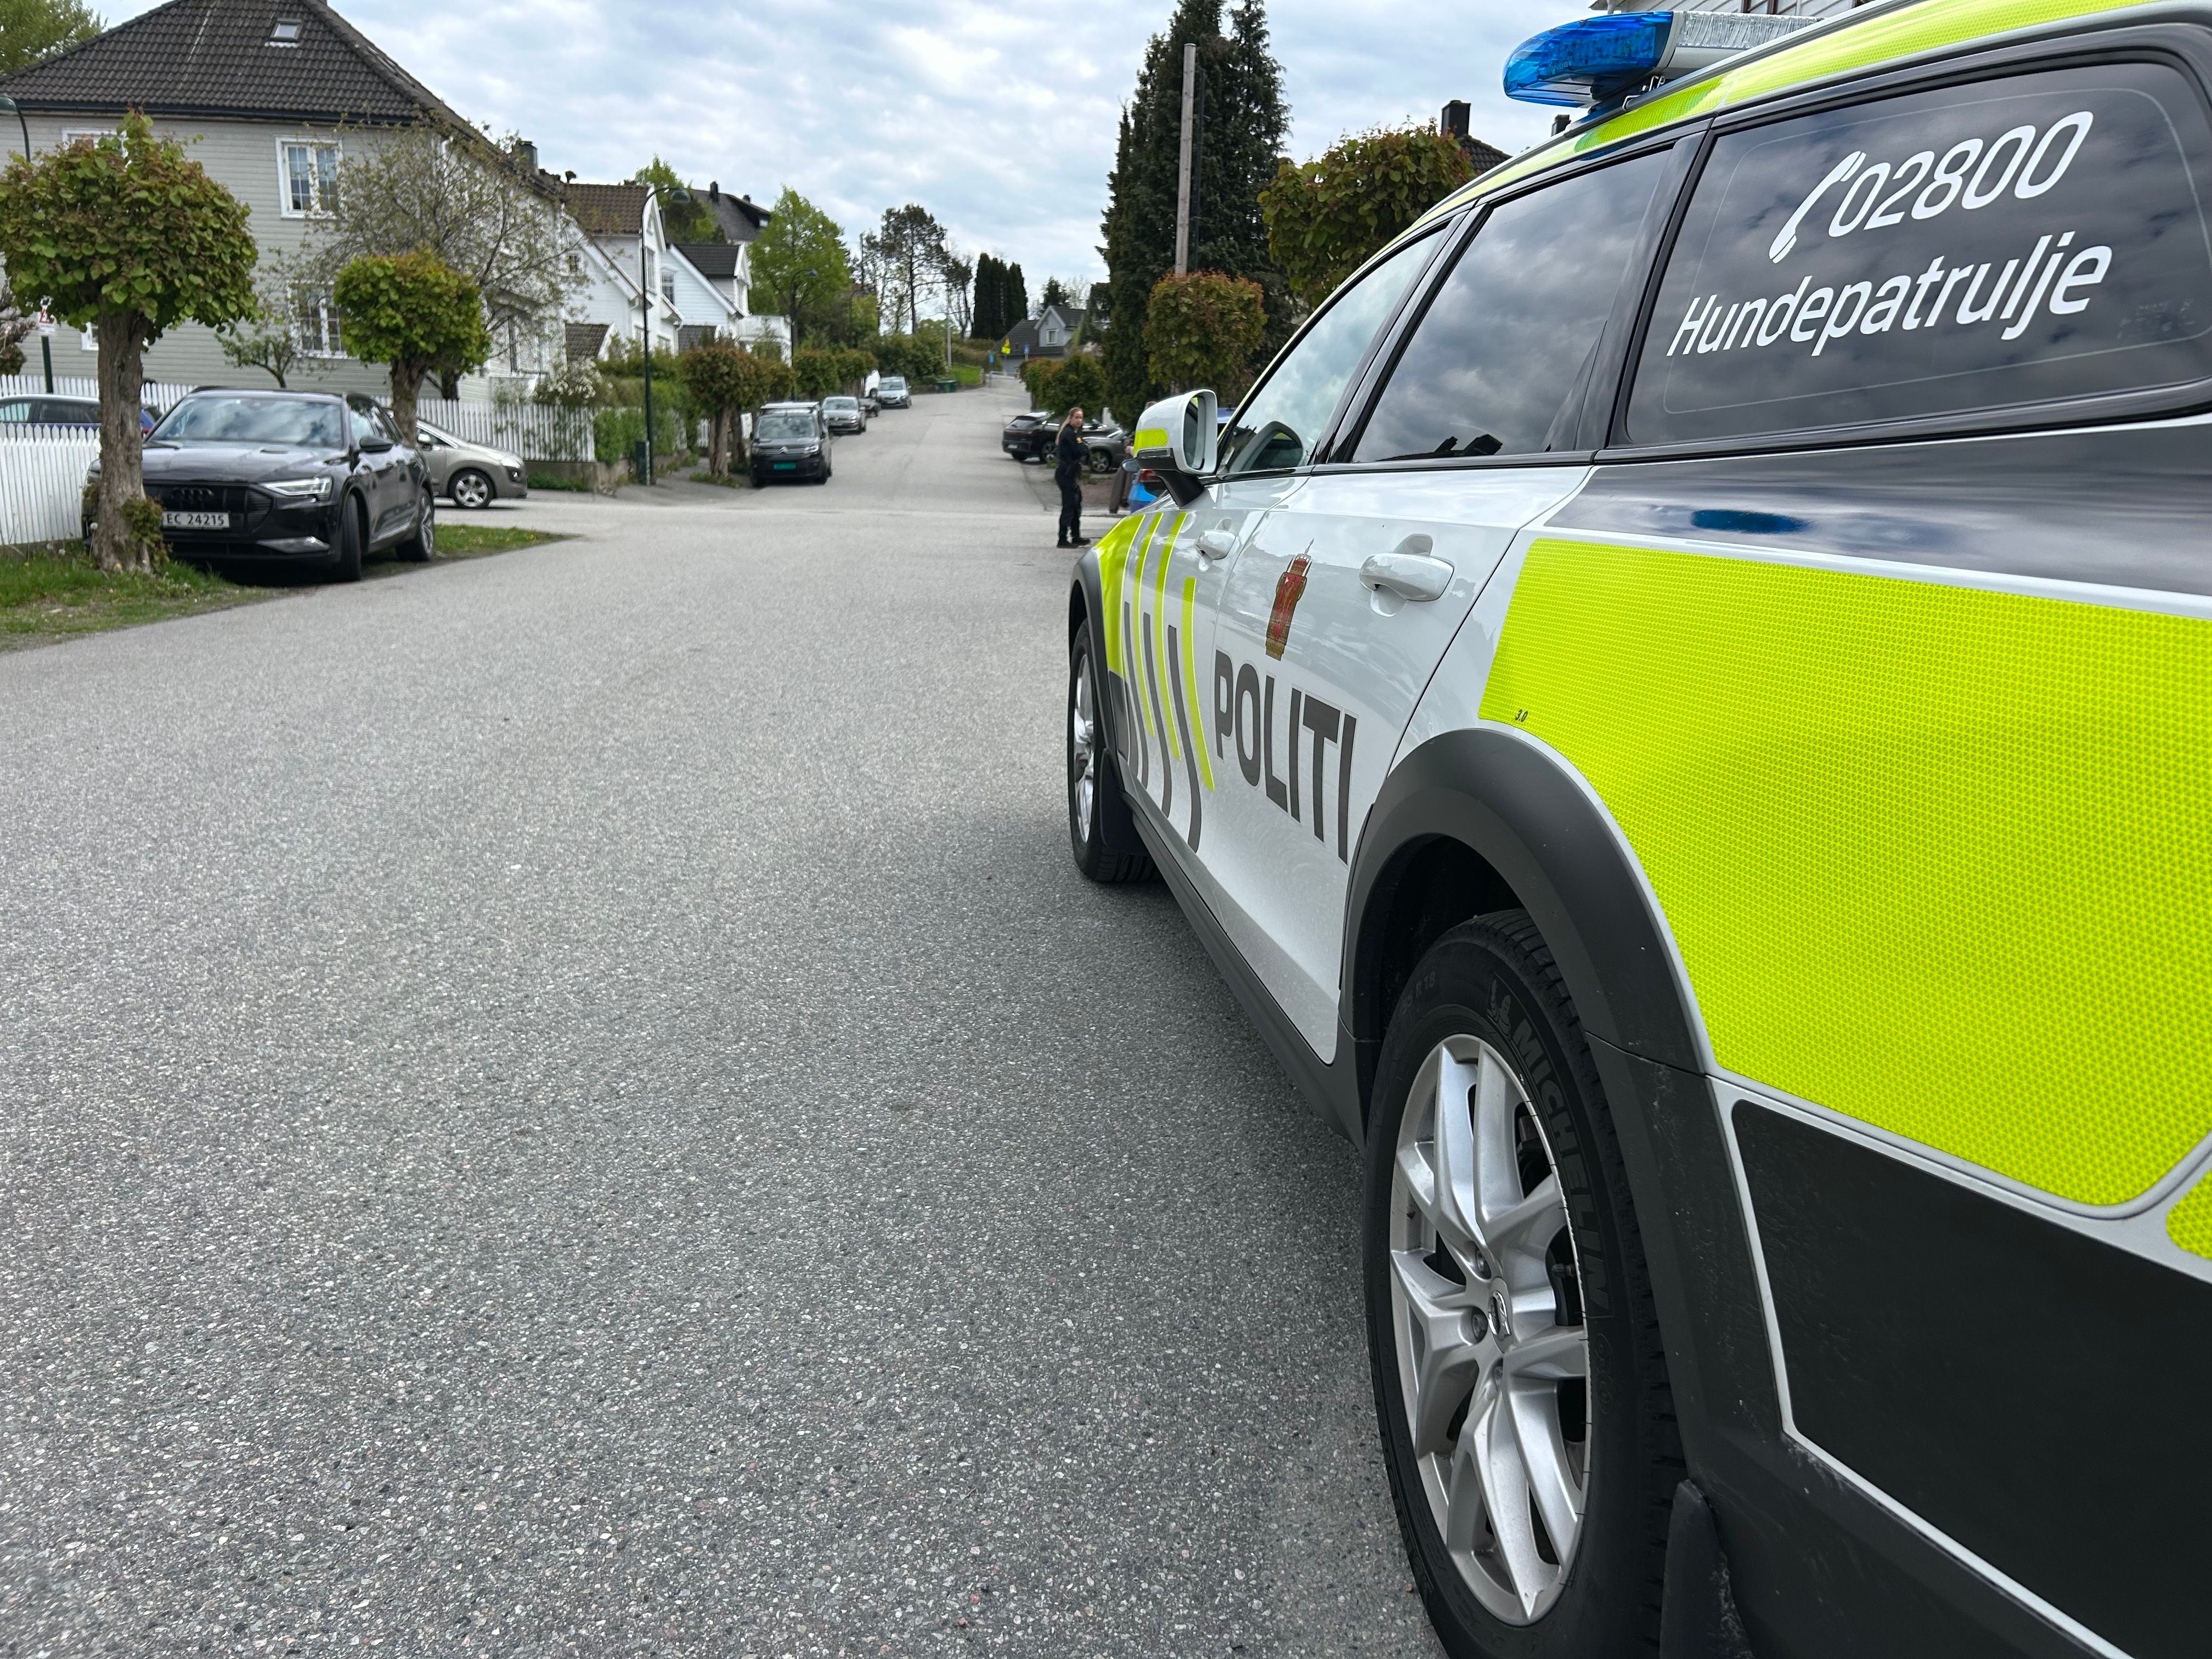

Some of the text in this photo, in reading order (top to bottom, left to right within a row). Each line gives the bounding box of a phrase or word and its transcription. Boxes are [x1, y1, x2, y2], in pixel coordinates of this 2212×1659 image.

[1829, 110, 2094, 238] 02800
[1666, 230, 2113, 357] Hundepatrulje
[166, 513, 224, 527] EC 24215
[1214, 648, 1356, 865] POLITI
[1515, 709, 1528, 722] 3.0
[1513, 1022, 1610, 1311] MICHELIN
